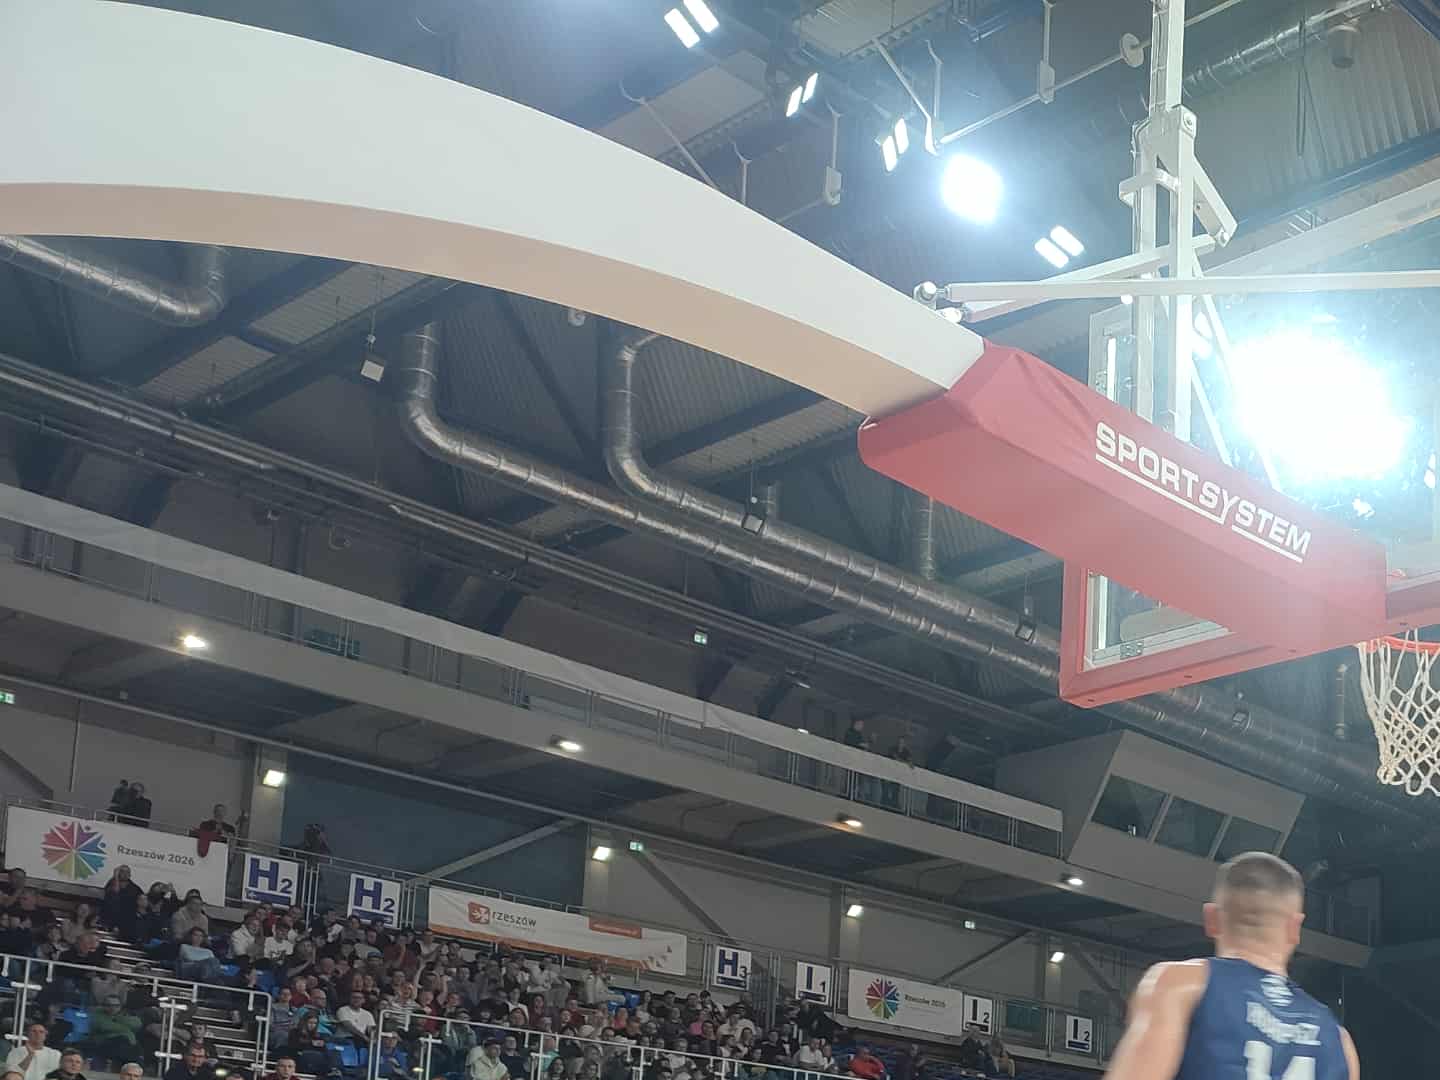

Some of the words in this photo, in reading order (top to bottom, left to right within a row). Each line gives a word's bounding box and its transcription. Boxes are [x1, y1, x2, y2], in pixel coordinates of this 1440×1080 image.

[1096, 421, 1311, 556] SPORTSYSTEM
[117, 845, 165, 861] Rzeszów
[167, 853, 195, 866] 2026
[250, 858, 293, 894] H2
[354, 878, 395, 913] H2
[492, 911, 537, 928] rzeszów
